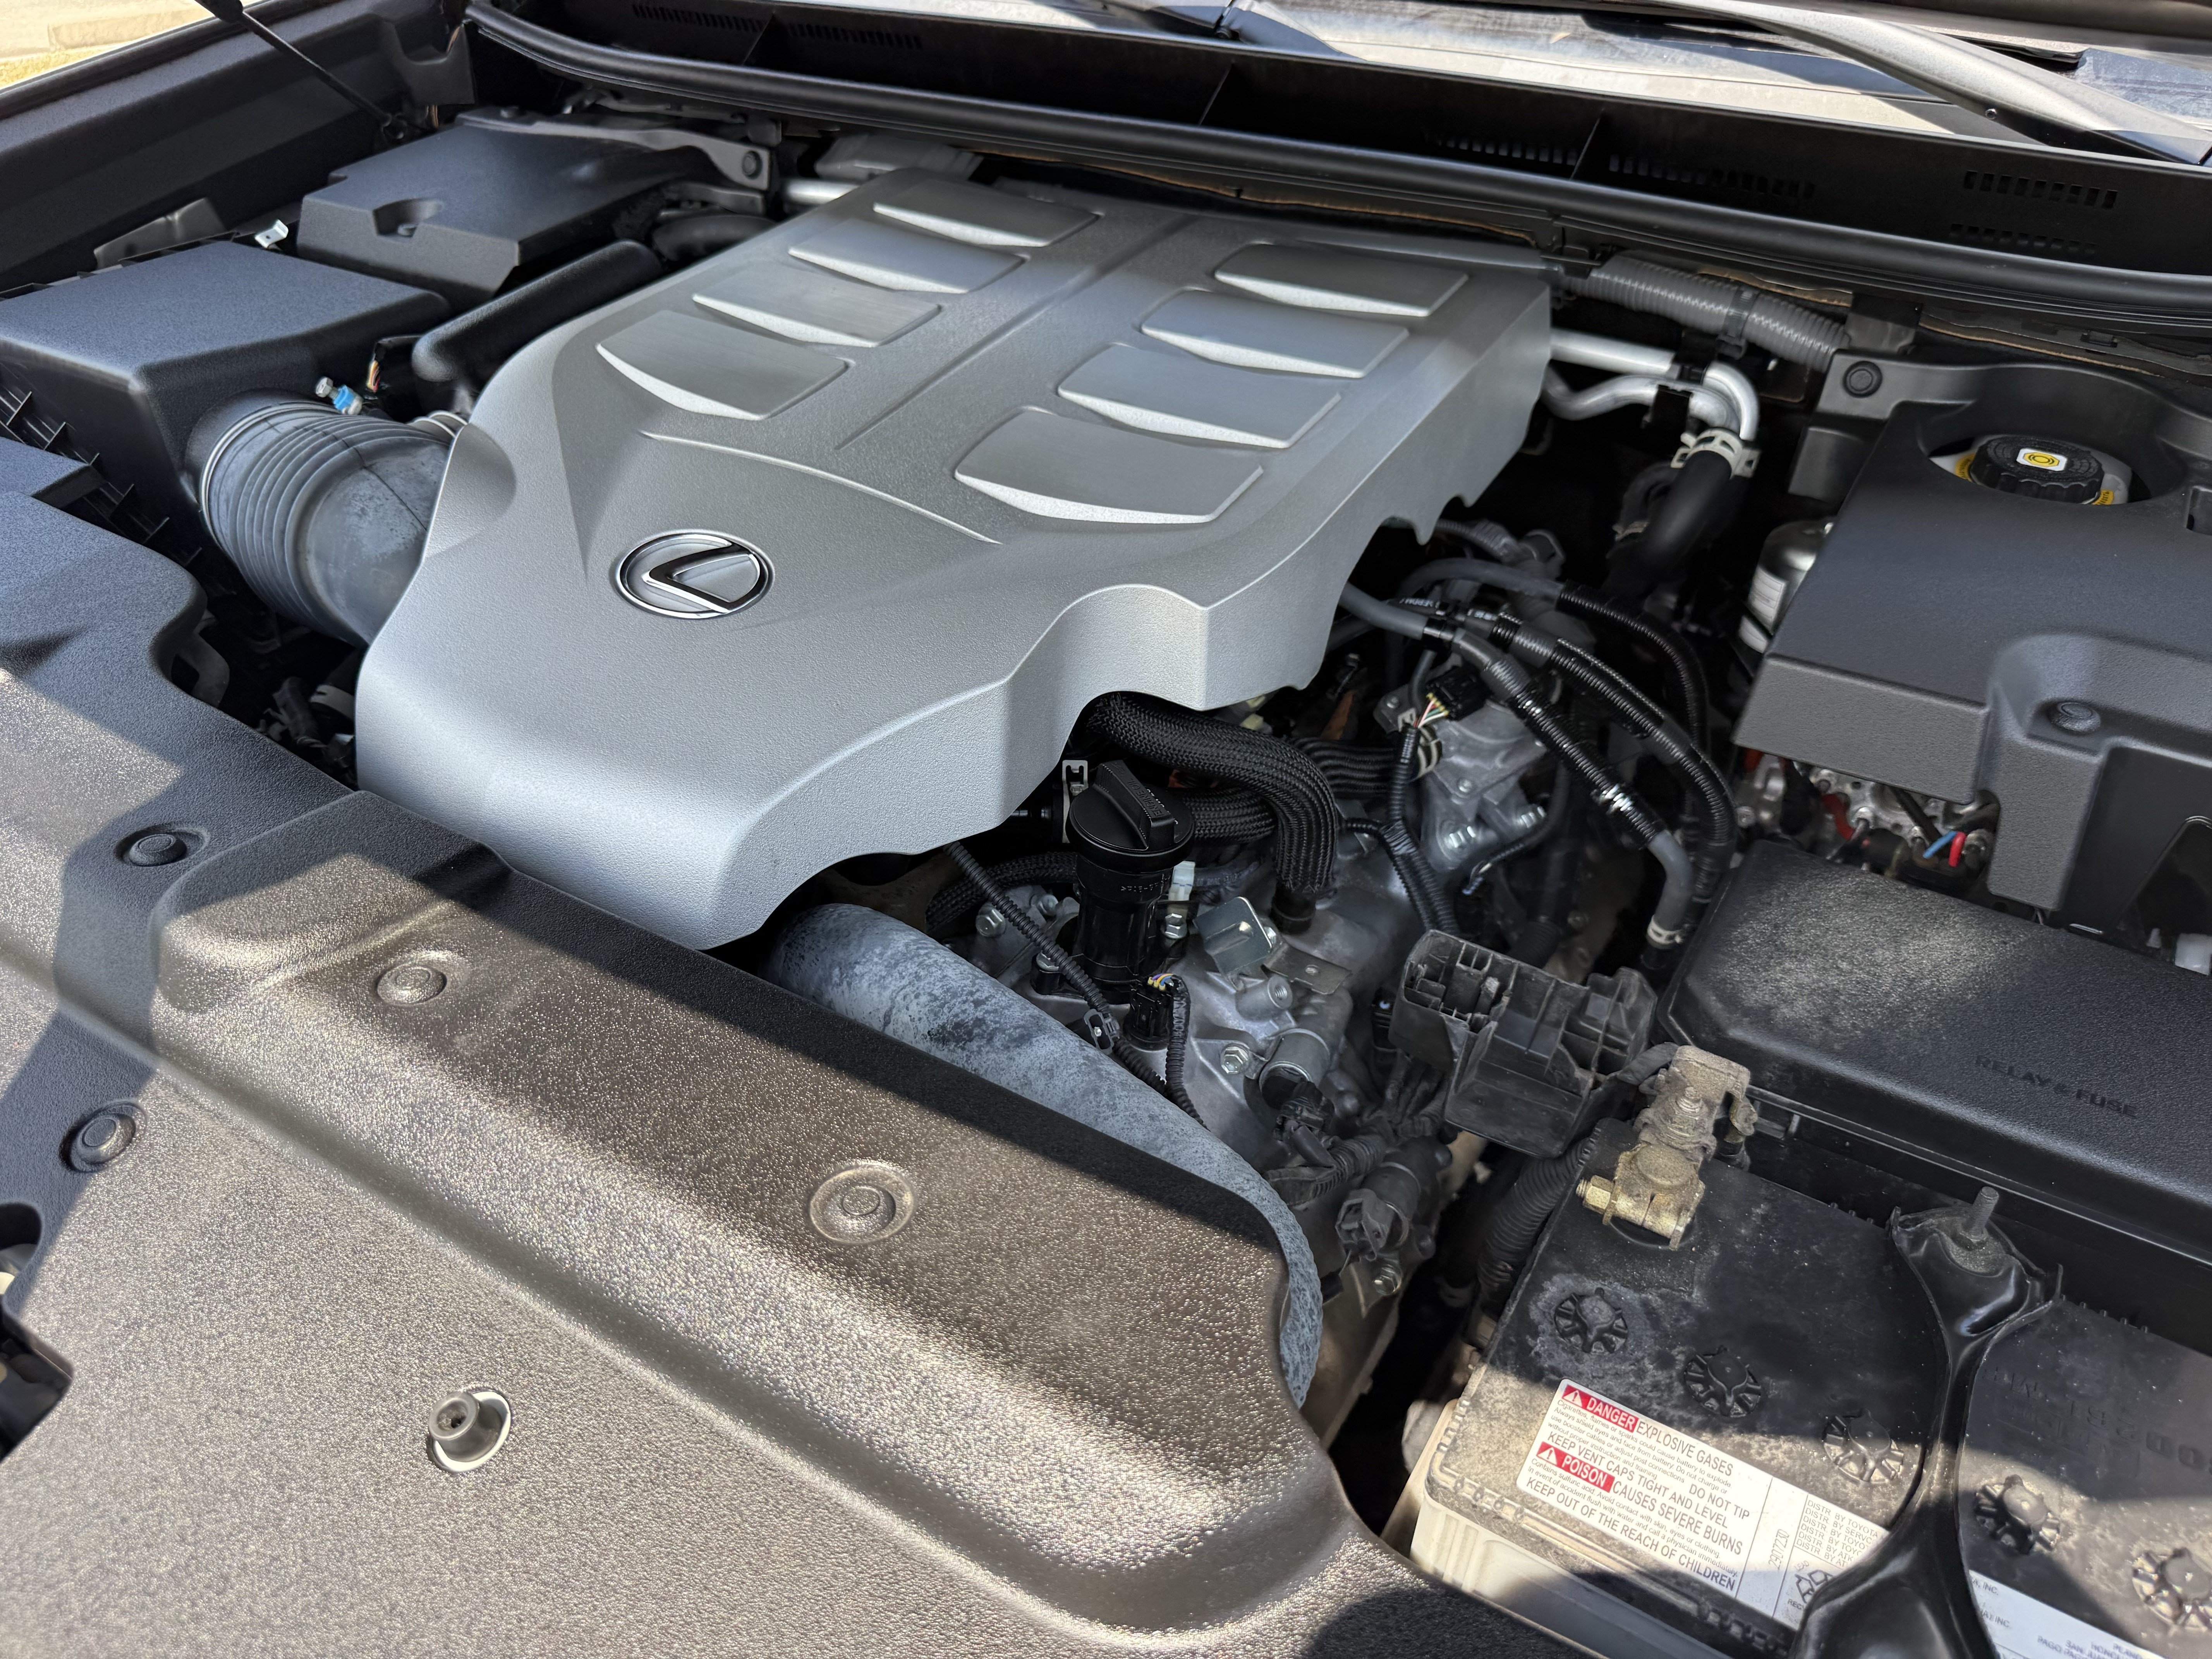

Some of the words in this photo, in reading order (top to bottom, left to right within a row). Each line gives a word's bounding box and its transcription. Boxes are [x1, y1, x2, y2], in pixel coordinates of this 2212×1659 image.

[1127, 779, 1140, 790] OIL
[1136, 790, 1164, 817] ENGINE
[1975, 1054, 2052, 1086] RELAY
[2076, 1089, 2138, 1120] FUSE
[1548, 1422, 1569, 1435] without
[1569, 1433, 1589, 1445] proper
[1590, 1443, 1621, 1461] instruction
[1622, 1459, 1634, 1467] and
[1551, 1415, 1562, 1423] use
[1563, 1420, 1585, 1434] booster
[1586, 1432, 1606, 1445] cables
[1614, 1446, 1633, 1458] adjust
[1633, 1455, 1647, 1465] post
[1648, 1462, 1685, 1483] connections
[1554, 1407, 1575, 1421] Always
[1576, 1418, 1594, 1430] shield
[1594, 1427, 1609, 1437] eyes
[1610, 1435, 1622, 1444] and
[1623, 1440, 1636, 1451] face
[1637, 1447, 1651, 1458] from
[1676, 1465, 1685, 1474] Do
[1686, 1472, 1697, 1480] not
[1698, 1477, 1719, 1491] charge
[1587, 1397, 1635, 1430] DANGER
[1636, 1420, 1695, 1458] EXPLOSIVE
[1697, 1449, 1733, 1476] GASES
[1590, 1415, 1609, 1429] flames
[1618, 1430, 1638, 1443] sparks
[1639, 1440, 1656, 1451] could
[1657, 1449, 1675, 1460] cause
[1676, 1456, 1698, 1472] battery
[1531, 1458, 1558, 1476] Contains
[1558, 1473, 1580, 1487] sulfuric
[1596, 1491, 1615, 1504] Avoid
[1615, 1502, 1638, 1516] contact
[1640, 1514, 1652, 1523] with
[1669, 1529, 1685, 1540] eyes
[1547, 1431, 1576, 1450] KEEP
[1578, 1445, 1606, 1466] VENT
[1606, 1460, 1635, 1481] CAPS
[1638, 1474, 1669, 1497] TIGHT
[1668, 1492, 1693, 1510] AND
[1694, 1503, 1728, 1528] LEVEL
[1535, 1471, 1553, 1482] event
[1560, 1483, 1586, 1499] accident
[1587, 1495, 1601, 1508] flush
[1603, 1504, 1616, 1515] with
[1617, 1511, 1634, 1523] water
[1635, 1522, 1648, 1531] and
[1649, 1528, 1661, 1537] call
[1666, 1537, 1697, 1556] physician
[1562, 1455, 1607, 1487] POISON
[1613, 1480, 1657, 1512] CAUSES
[1658, 1503, 1703, 1535] SEVERE
[1703, 1525, 1743, 1555] BURNS
[1689, 1483, 1705, 1499] DO
[1707, 1492, 1731, 1511] NOT
[1734, 1504, 1750, 1520] TIP
[1526, 1477, 1555, 1497] KEEP
[1556, 1492, 1580, 1511] OUT
[1580, 1505, 1597, 1518] OF
[1598, 1512, 1620, 1532] THE
[1620, 1524, 1659, 1552] REACH
[1661, 1545, 1677, 1559] OF
[1679, 1554, 1736, 1591] CHILDREN
[1828, 1536, 1839, 1546] BY
[1830, 1528, 1841, 1538] BY
[1832, 1520, 1843, 1530] BY
[1835, 1513, 1846, 1522] BY
[1848, 1518, 1878, 1539] TOYOTA
[1768, 1528, 1790, 1570] 2907230
[1794, 1560, 1809, 1571] LEAD
[1824, 1552, 1836, 1562] BY
[1826, 1544, 1837, 1554] BY
[1983, 1582, 1999, 1595] INC.
